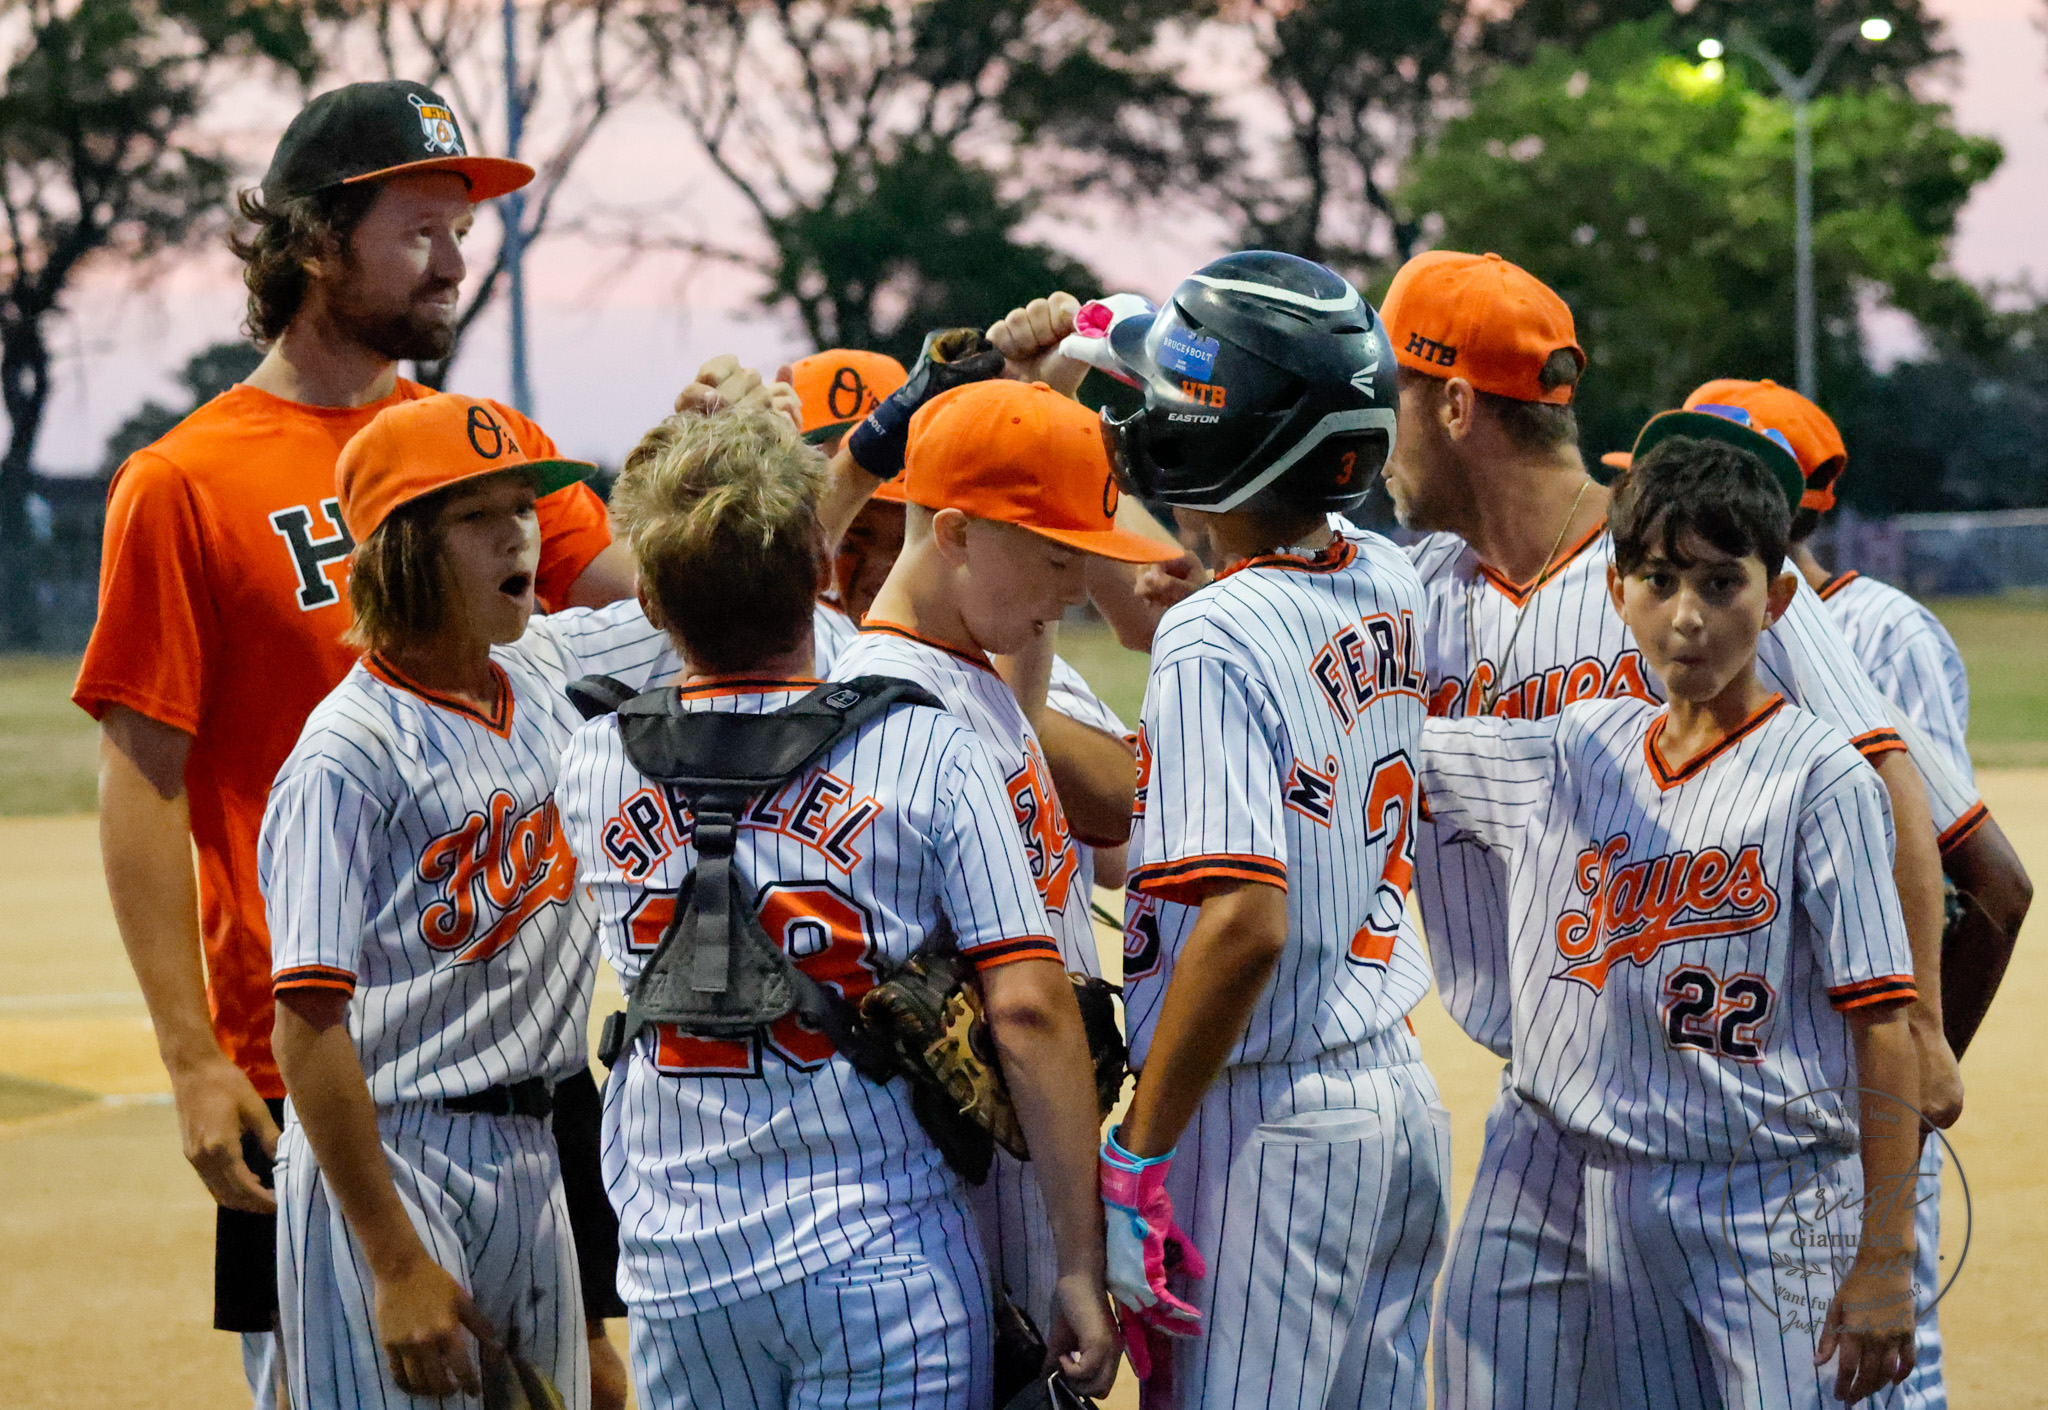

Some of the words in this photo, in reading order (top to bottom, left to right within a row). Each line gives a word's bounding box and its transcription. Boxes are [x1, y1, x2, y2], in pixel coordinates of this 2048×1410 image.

[1163, 336, 1187, 353] BRUCE
[1189, 348, 1213, 362] BOLT
[1405, 332, 1457, 367] HTB
[1179, 380, 1227, 408] HTB
[1168, 412, 1220, 424] EASTON
[1336, 451, 1357, 485] 3
[1283, 754, 1339, 829] M.
[600, 766, 884, 883] SPEZEL
[1549, 832, 1781, 997] Hayes
[1662, 964, 1777, 1063] 22
